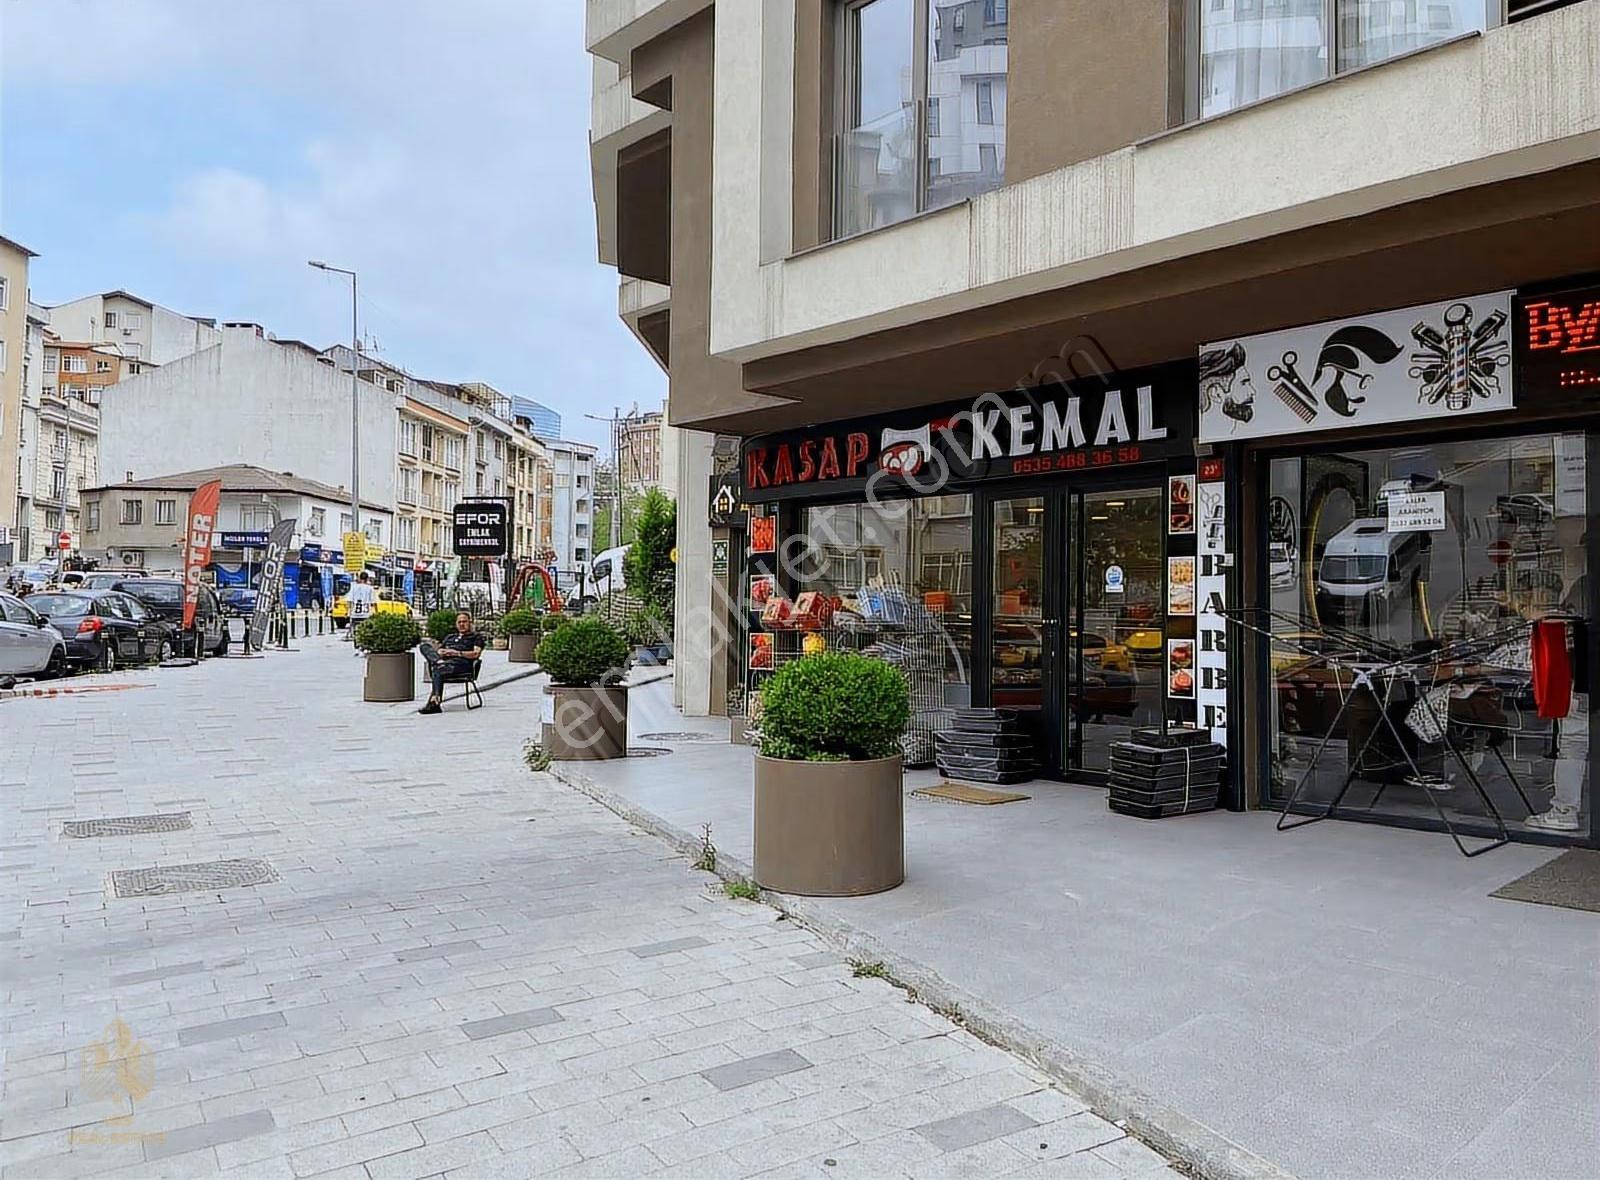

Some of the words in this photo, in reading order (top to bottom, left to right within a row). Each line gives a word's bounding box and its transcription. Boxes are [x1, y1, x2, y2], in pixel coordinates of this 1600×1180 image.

[971, 385, 1168, 460] KEMAL
[746, 432, 869, 489] KASAP
[1012, 457, 1052, 474] 0535
[455, 513, 502, 525] EFOR
[186, 514, 213, 604] NOTER
